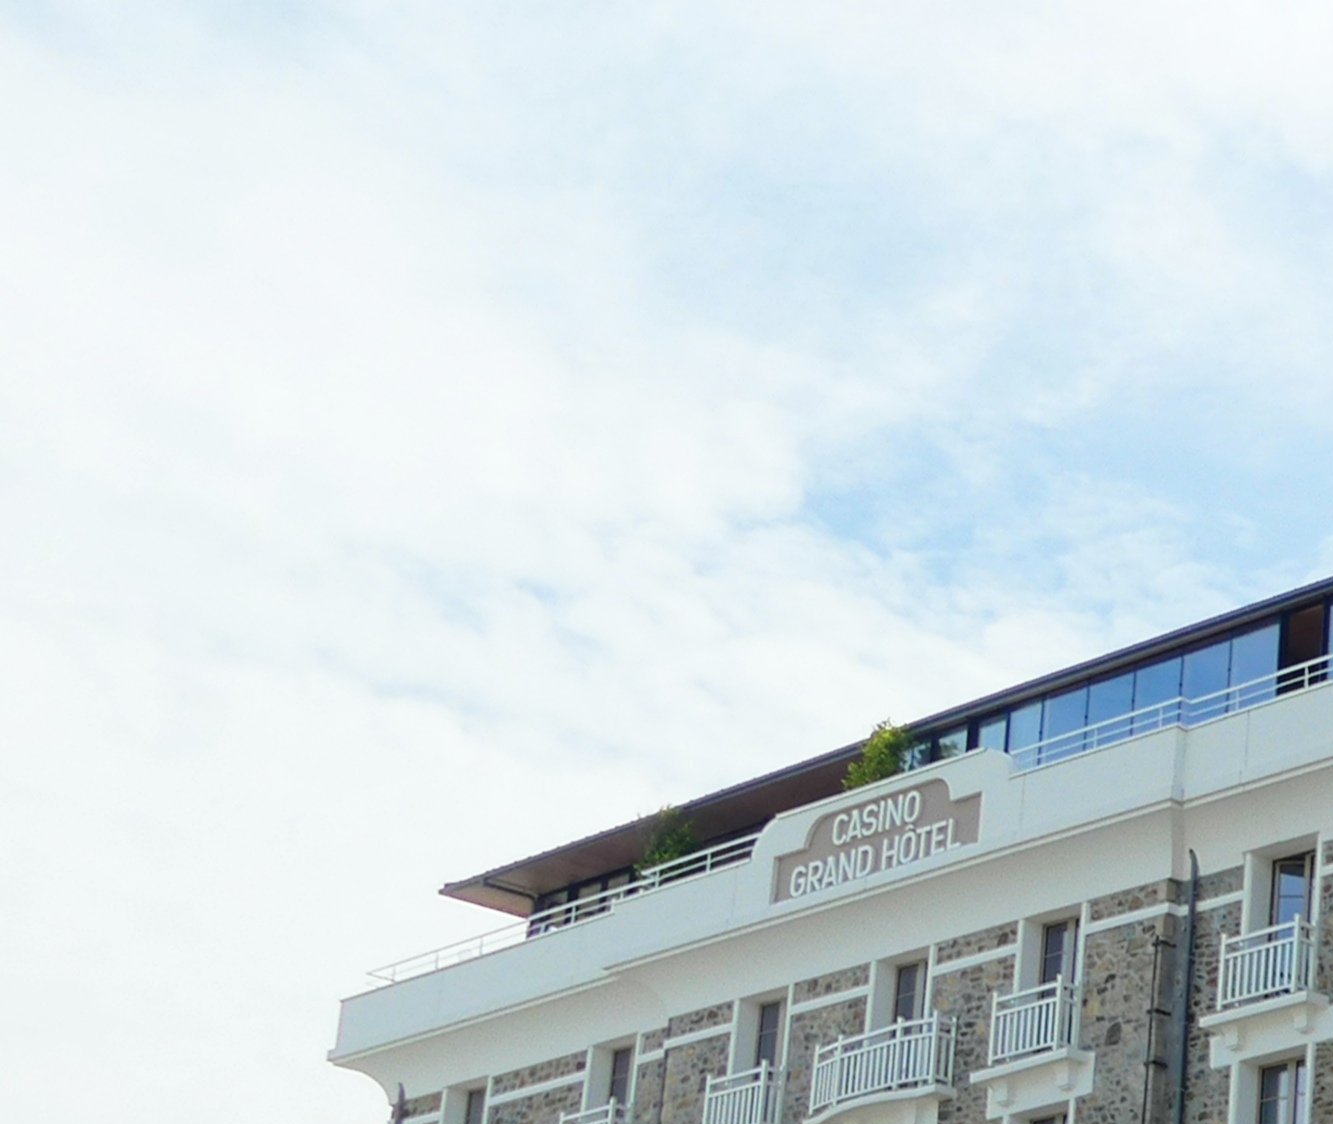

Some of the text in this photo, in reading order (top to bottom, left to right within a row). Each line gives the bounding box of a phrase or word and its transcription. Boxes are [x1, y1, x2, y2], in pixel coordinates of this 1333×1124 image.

[832, 789, 921, 846] CASINO
[790, 817, 962, 898] GRAND HÔTEL
